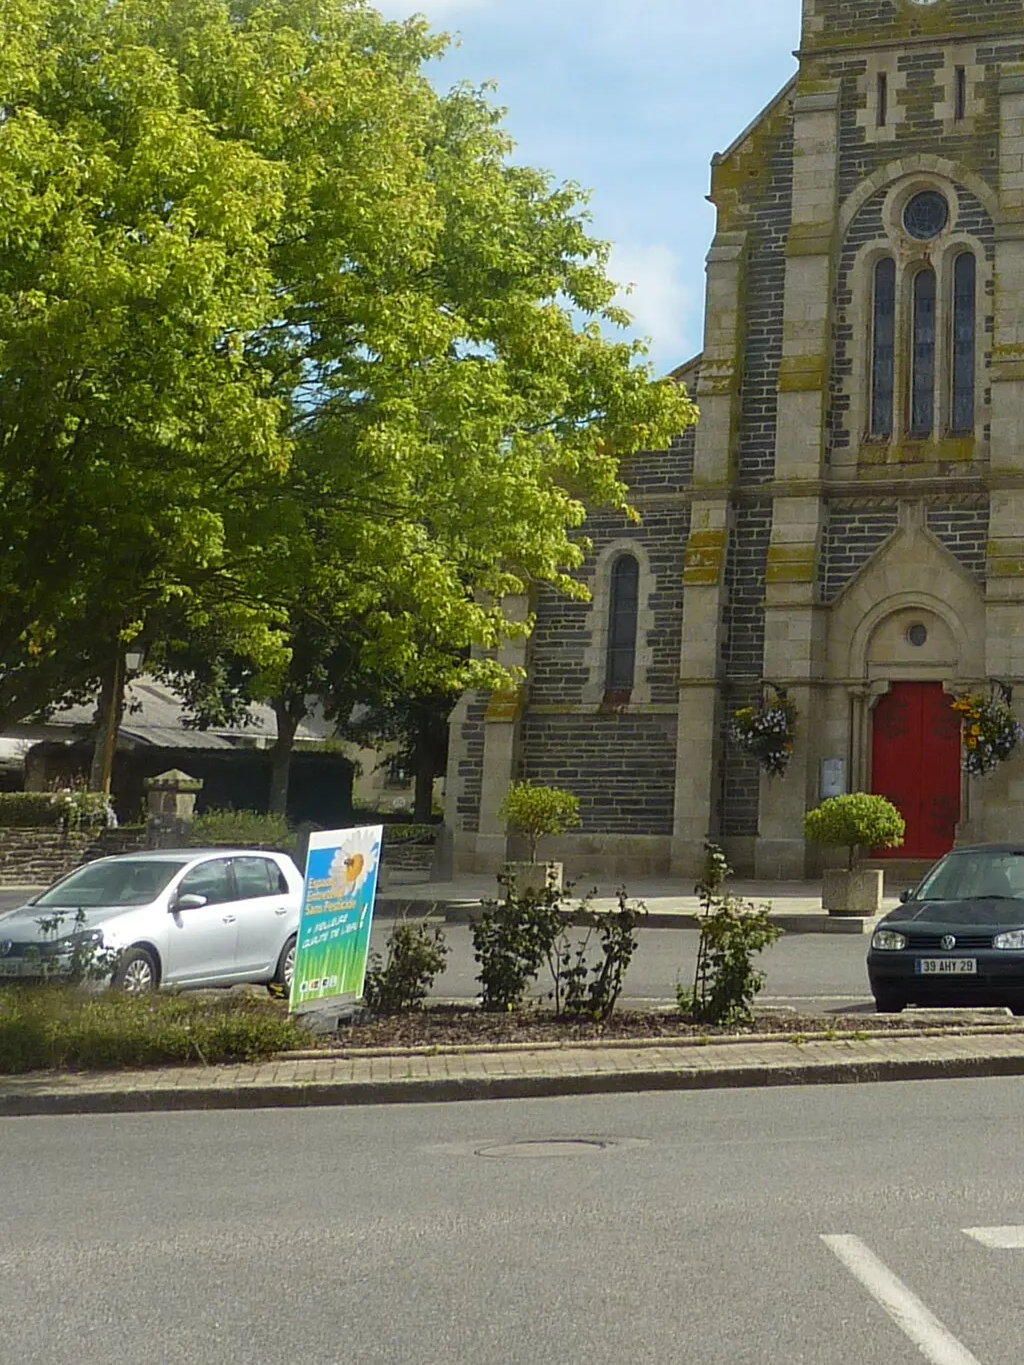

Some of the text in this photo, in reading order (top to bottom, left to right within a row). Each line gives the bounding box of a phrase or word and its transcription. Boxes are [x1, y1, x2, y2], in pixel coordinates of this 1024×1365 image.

[924, 960, 973, 972] 39 AHY 29
